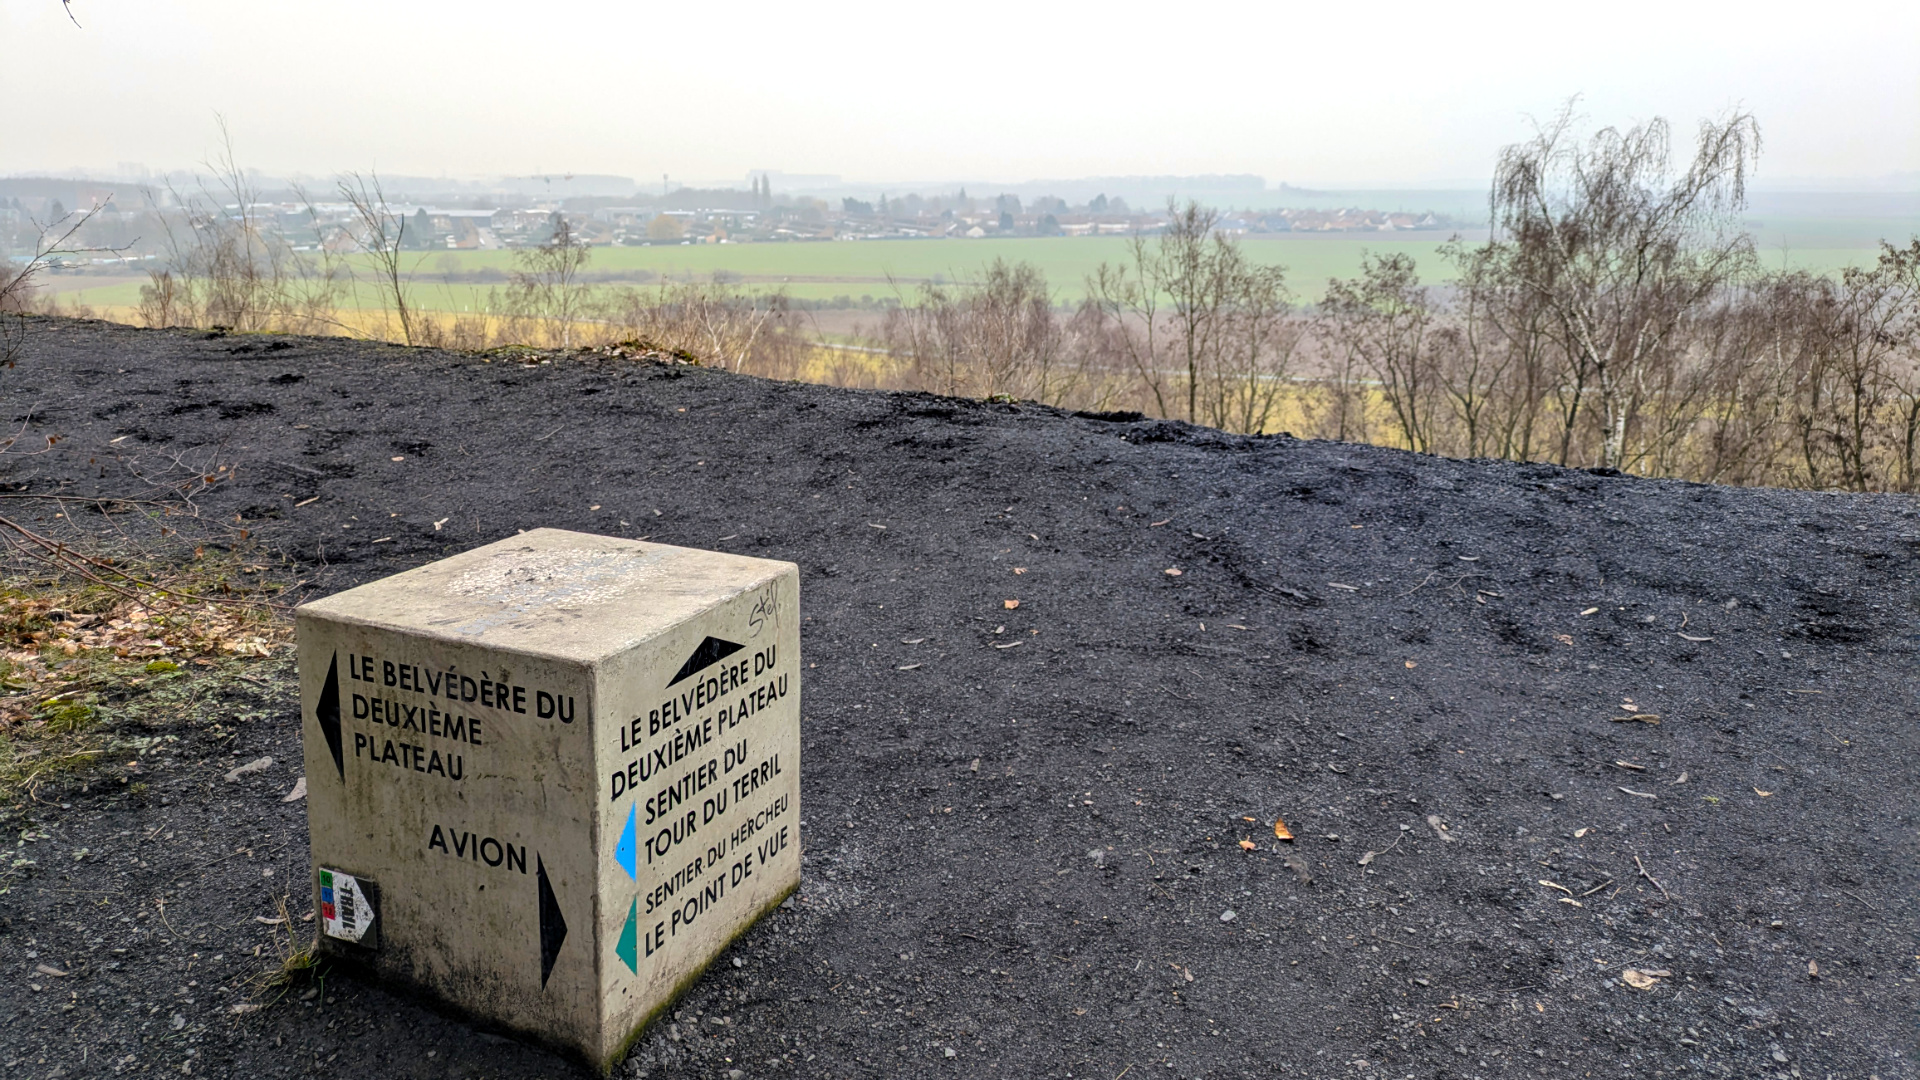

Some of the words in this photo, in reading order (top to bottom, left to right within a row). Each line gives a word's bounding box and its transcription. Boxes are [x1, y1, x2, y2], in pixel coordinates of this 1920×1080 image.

[350, 653, 375, 683] LE
[383, 660, 527, 714] BELVÉDÈRE
[536, 690, 575, 724] DU
[352, 693, 482, 746] DEUXIÈME
[621, 717, 641, 753] LE
[649, 659, 748, 737] BELVÉDÈRE
[755, 644, 776, 677] DU
[354, 732, 463, 781] PLATEAU
[611, 717, 712, 801] DEUXIÈME
[718, 672, 788, 735] PLATEAU
[645, 758, 718, 825] SENTIER
[724, 739, 747, 774] DU
[645, 810, 697, 865] TOUR
[703, 788, 727, 825] DU
[733, 753, 782, 803] TERRIL
[322, 875, 331, 885] 10
[428, 824, 527, 875] AVION
[645, 856, 703, 914] SENTIER
[708, 838, 726, 868] DU
[731, 792, 788, 850] HERCHEU
[340, 887, 356, 929] TRAIL
[645, 921, 664, 958] LE
[671, 873, 726, 937] POINT
[732, 852, 752, 888] DE
[758, 825, 788, 865] VUE
